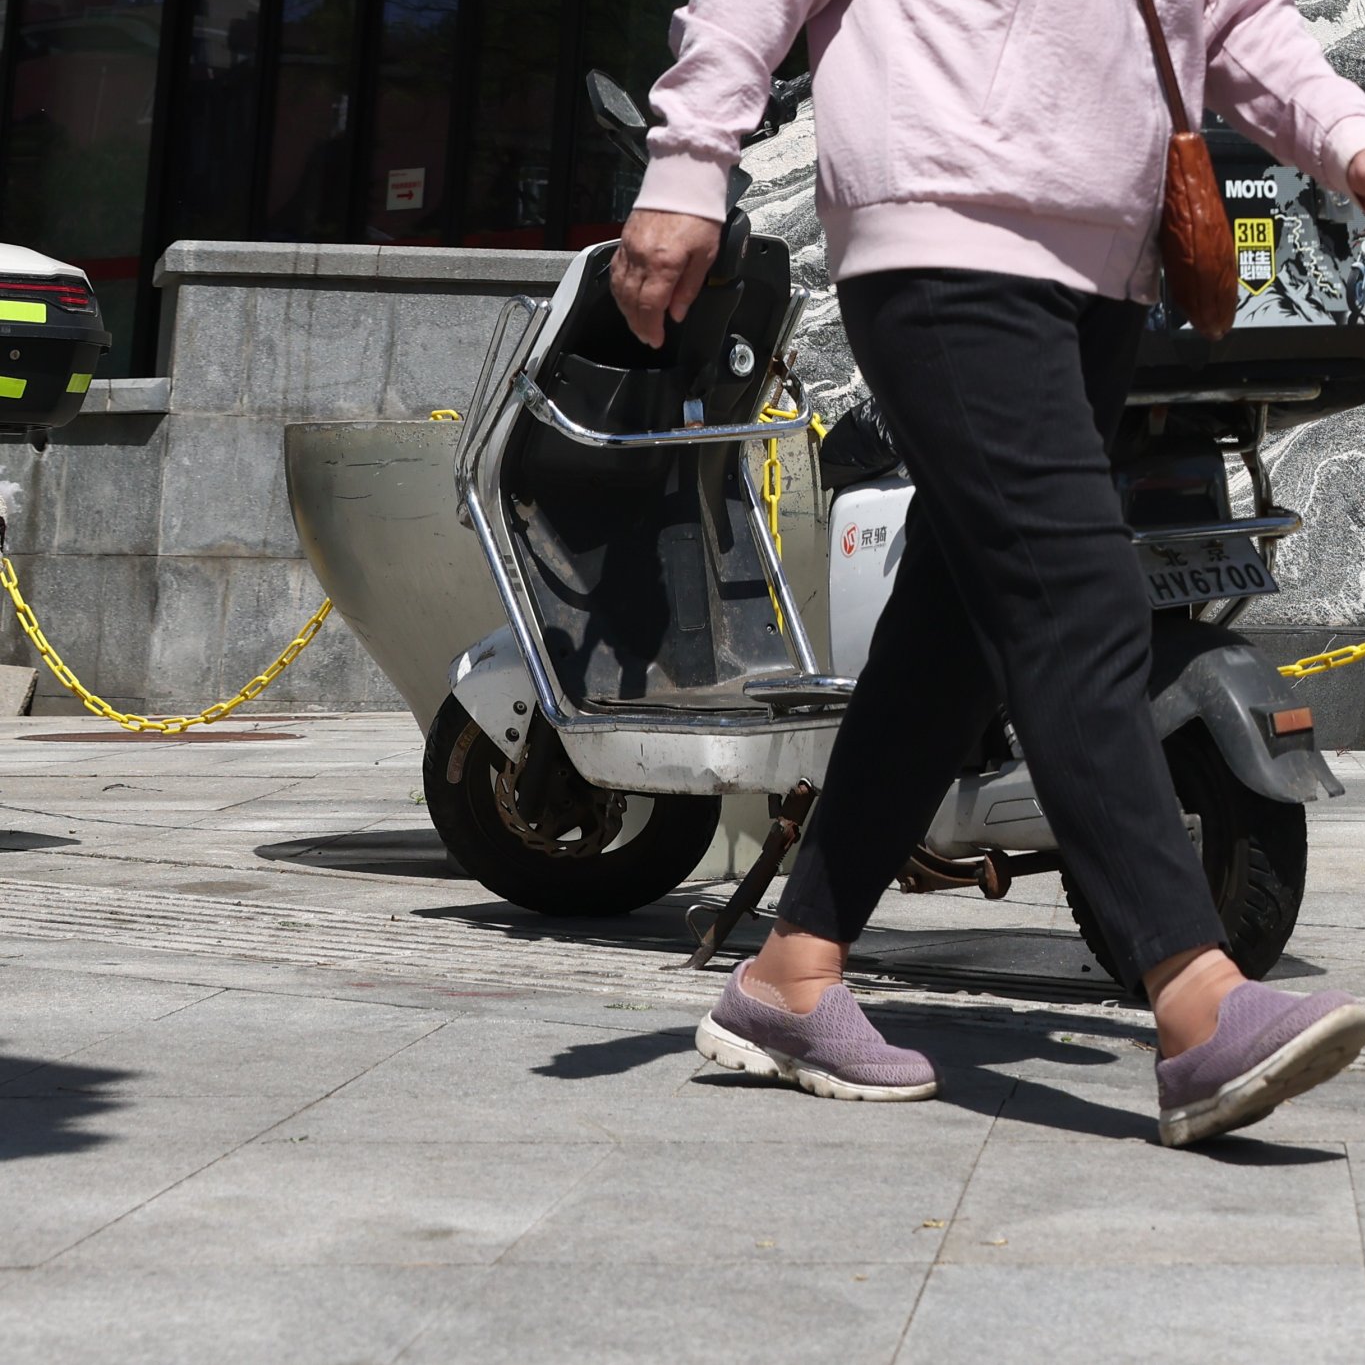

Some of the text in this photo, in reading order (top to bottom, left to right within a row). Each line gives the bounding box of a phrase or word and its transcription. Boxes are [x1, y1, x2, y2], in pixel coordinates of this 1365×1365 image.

[1225, 180, 1278, 199] MOTO
[1238, 222, 1267, 243] 318
[1149, 563, 1266, 601] HV6700
